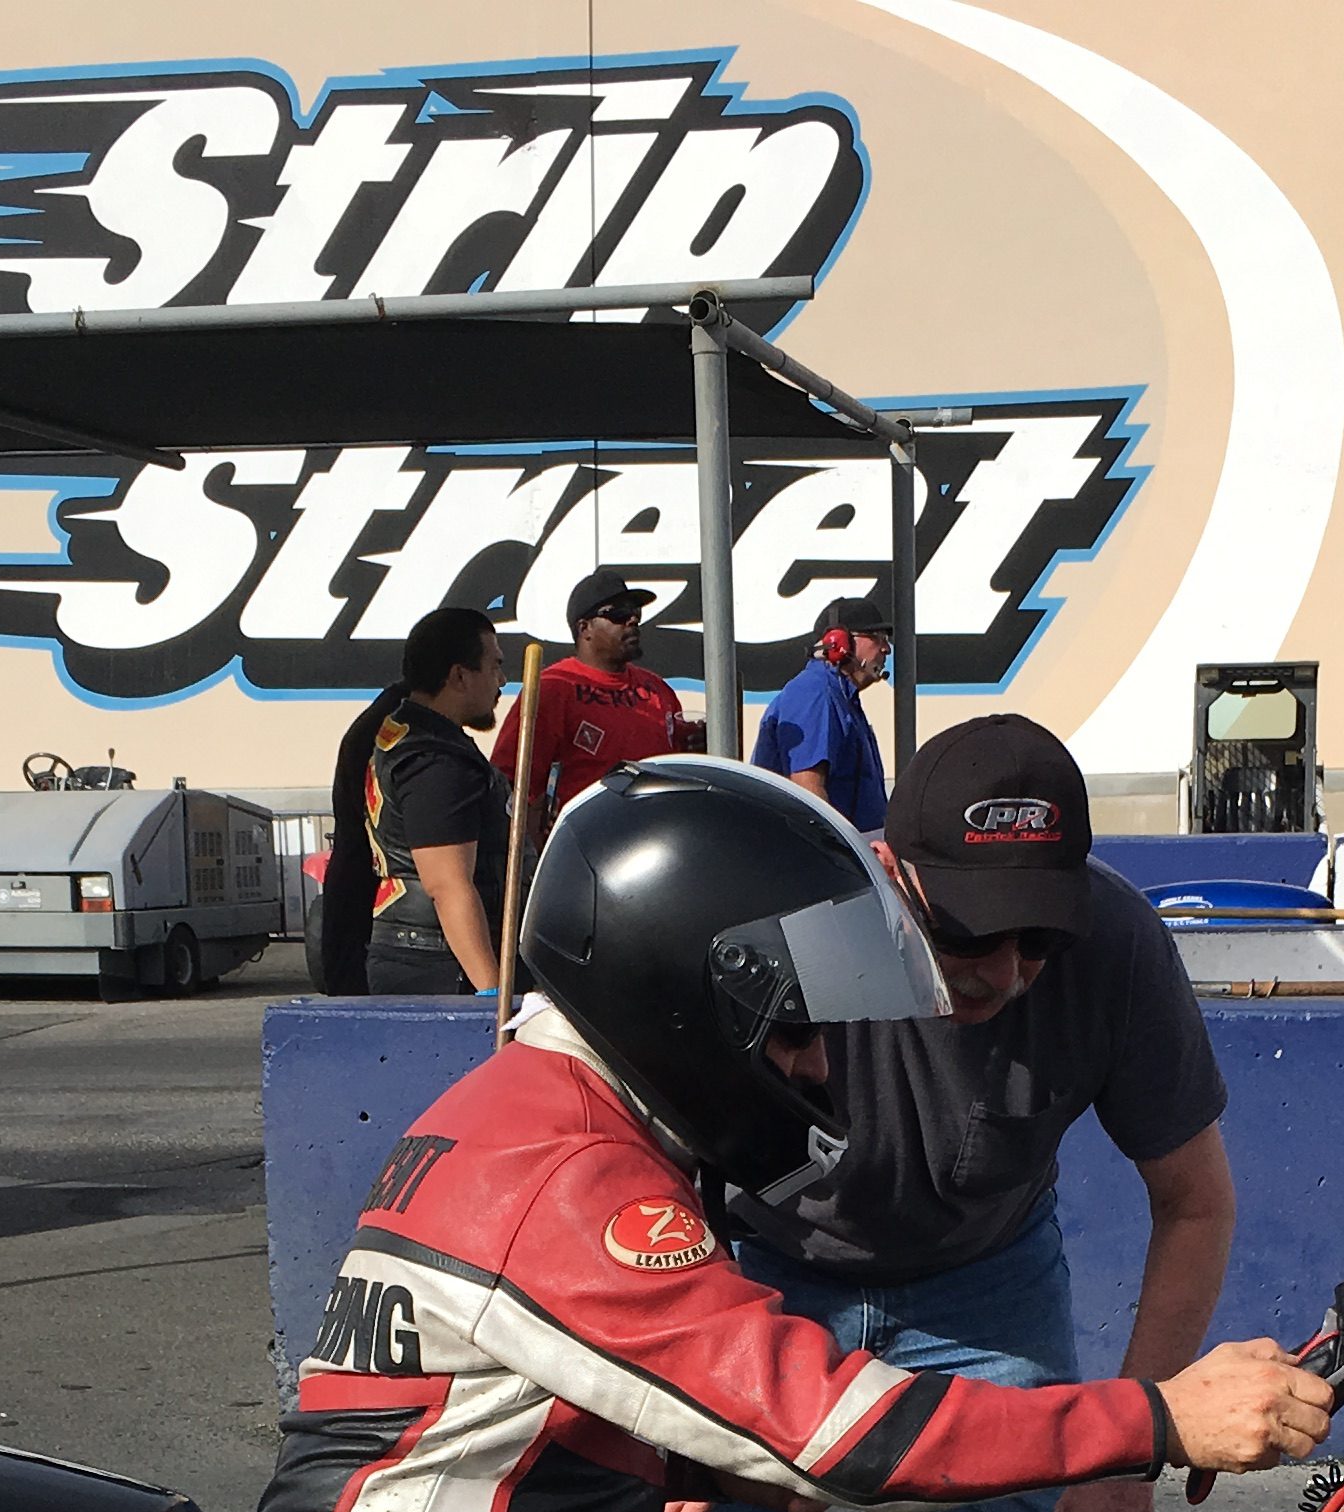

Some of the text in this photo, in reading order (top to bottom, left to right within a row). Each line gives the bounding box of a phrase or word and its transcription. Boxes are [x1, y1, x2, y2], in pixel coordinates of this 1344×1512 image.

[27, 75, 845, 323] Strip
[58, 415, 1104, 651] Street
[983, 806, 1048, 829] PR
[638, 1204, 691, 1247] Z
[635, 1244, 708, 1267] LEATHERS
